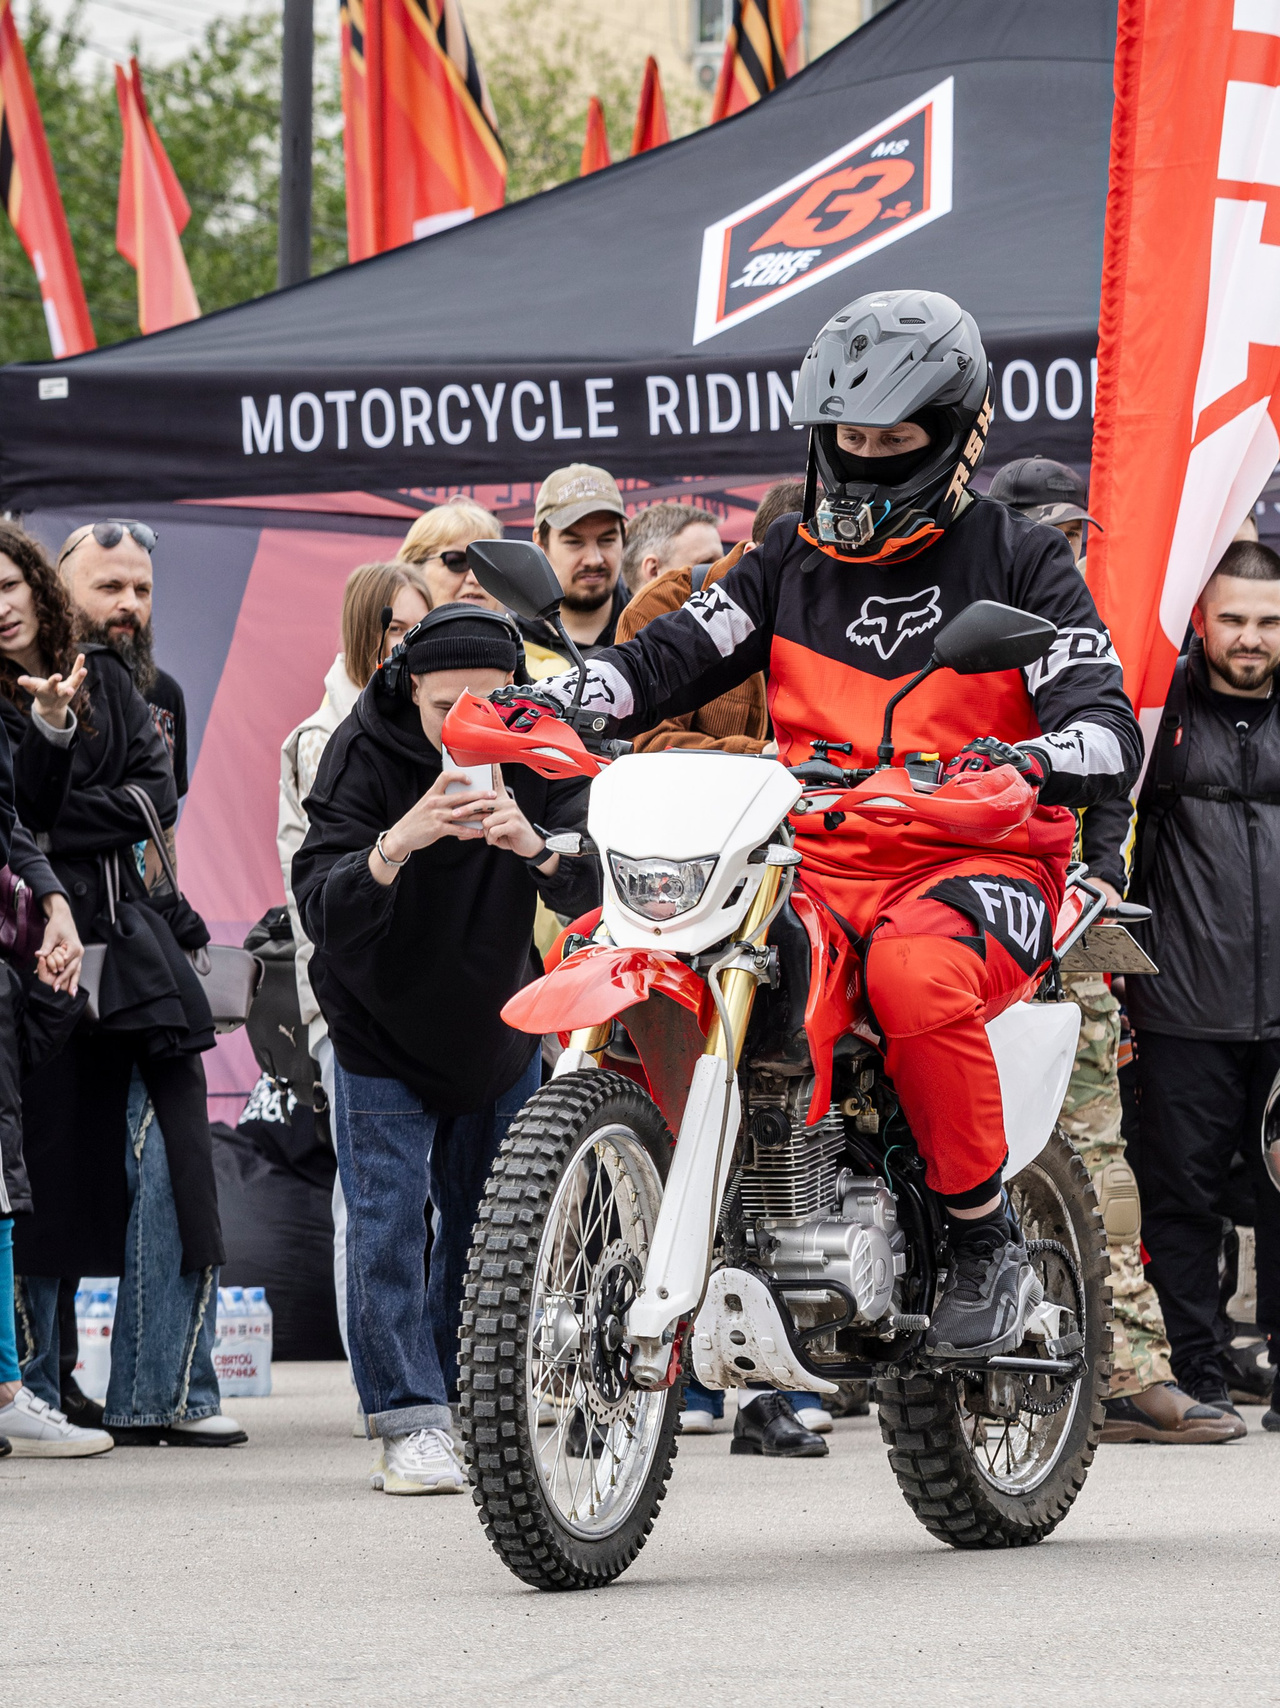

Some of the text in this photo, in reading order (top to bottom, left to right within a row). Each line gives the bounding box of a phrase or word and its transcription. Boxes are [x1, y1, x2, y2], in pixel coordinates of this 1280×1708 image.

[871, 139, 909, 158] MS
[240, 377, 619, 455] MOTORCYCLE
[646, 371, 804, 436] RIDIN
[968, 880, 1046, 960] FOX
